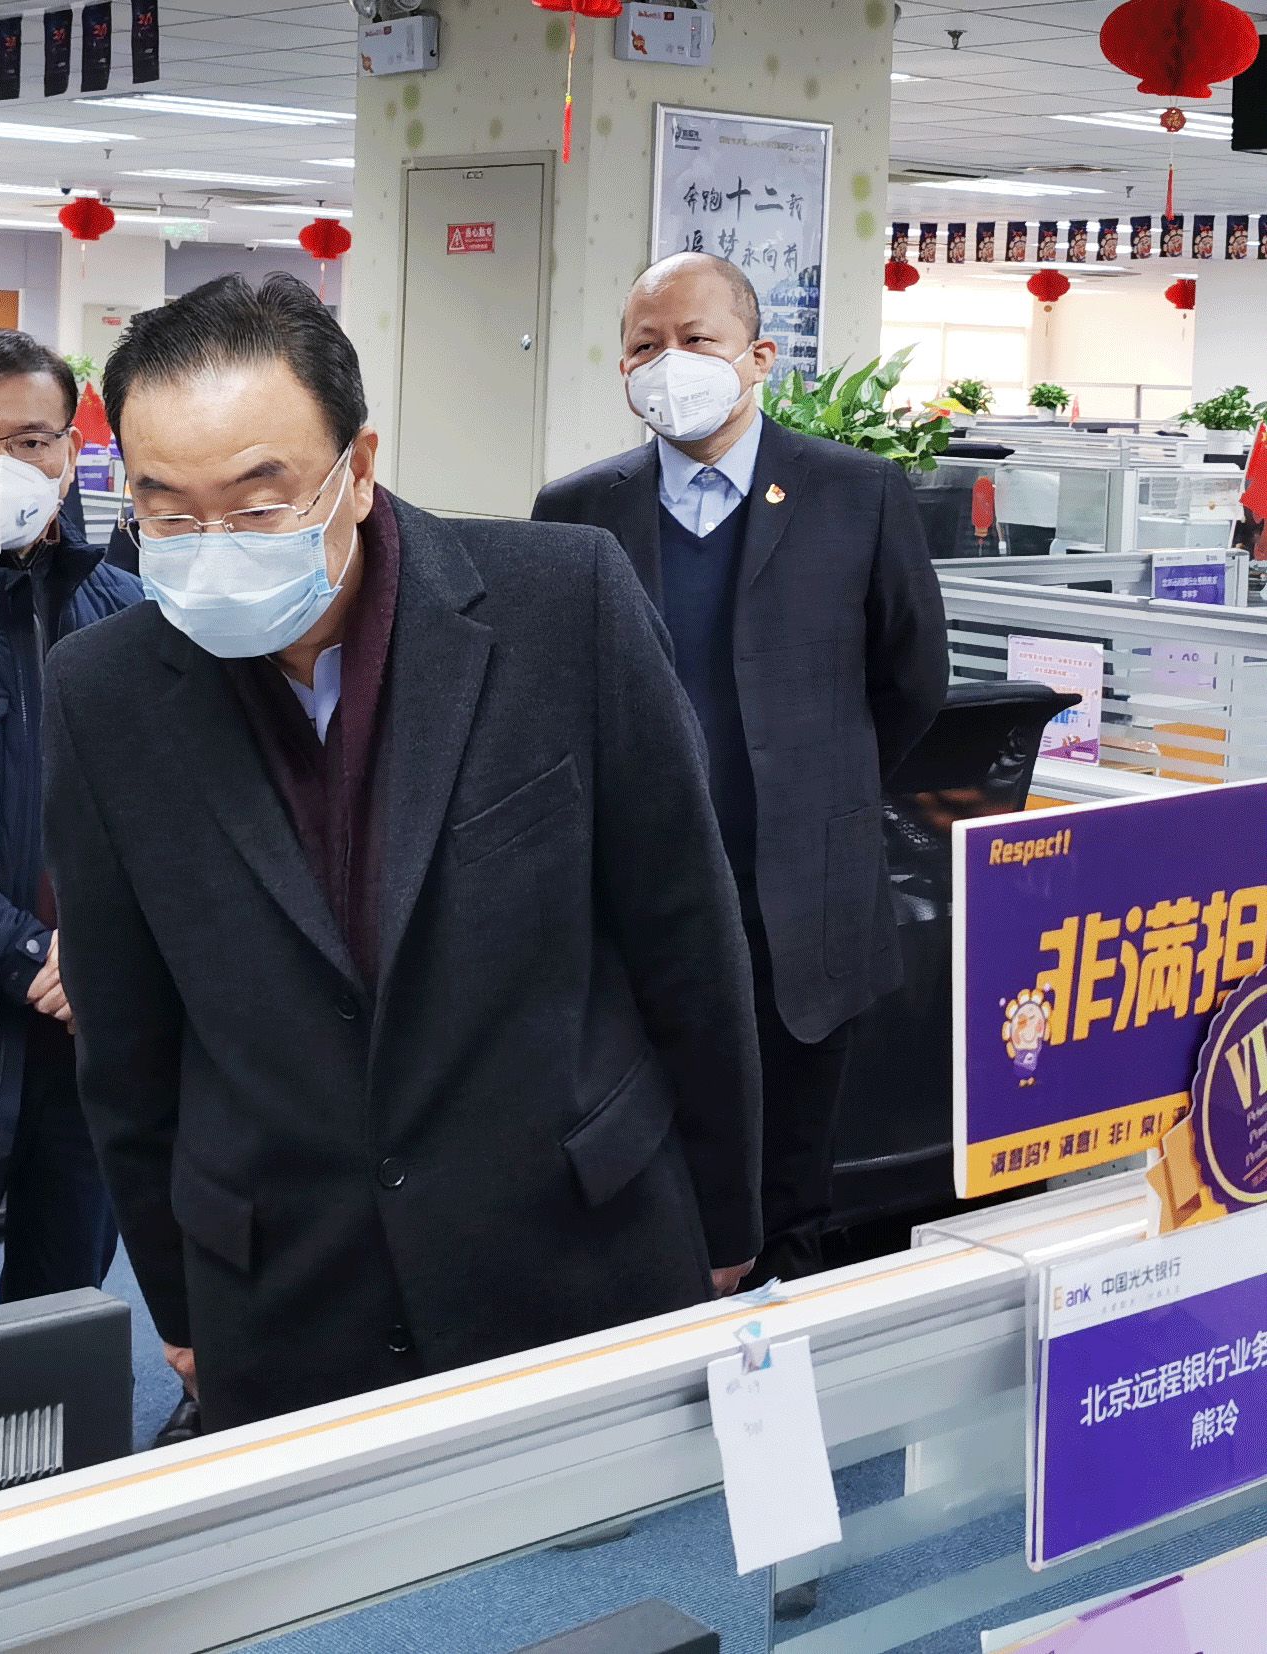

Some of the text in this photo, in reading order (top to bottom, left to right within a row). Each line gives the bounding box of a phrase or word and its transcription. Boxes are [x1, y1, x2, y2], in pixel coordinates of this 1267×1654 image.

[989, 829, 1072, 866] Respect!
[1101, 1256, 1182, 1297] 中国光大银行
[1080, 1330, 1267, 1427] 北京远程银行业务
[1190, 1398, 1240, 1450] 熊玲
